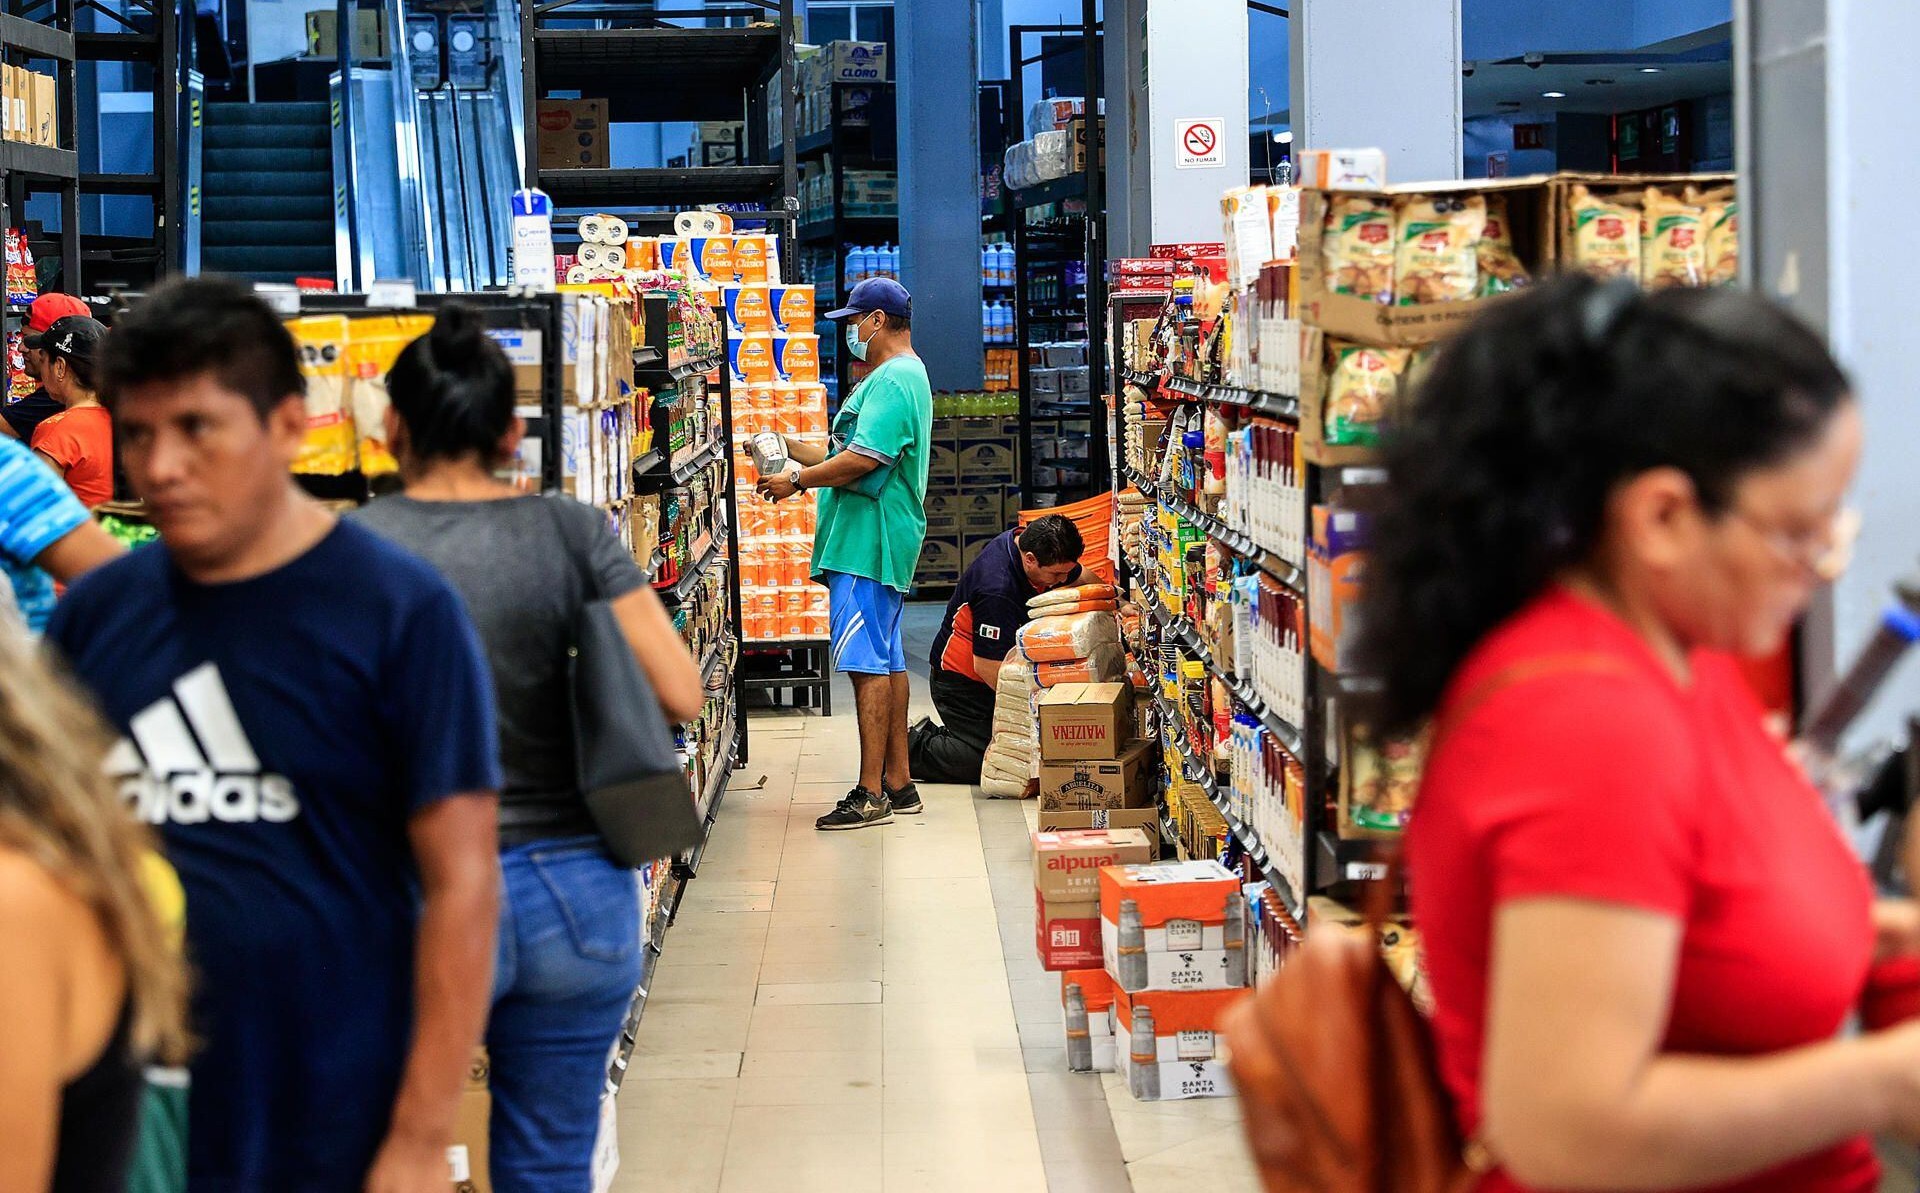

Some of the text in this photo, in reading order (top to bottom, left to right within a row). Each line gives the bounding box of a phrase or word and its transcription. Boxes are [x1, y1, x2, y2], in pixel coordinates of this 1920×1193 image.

[842, 68, 878, 78] CLORO
[704, 258, 732, 268] Clásico
[782, 308, 812, 318] Clásico
[55, 341, 72, 353] POLO
[785, 358, 815, 367] Clásico
[1052, 725, 1105, 740] MAIZENA
[1064, 780, 1100, 792] ABUELITA
[118, 769, 299, 825] didas
[1067, 877, 1097, 886] SEMI
